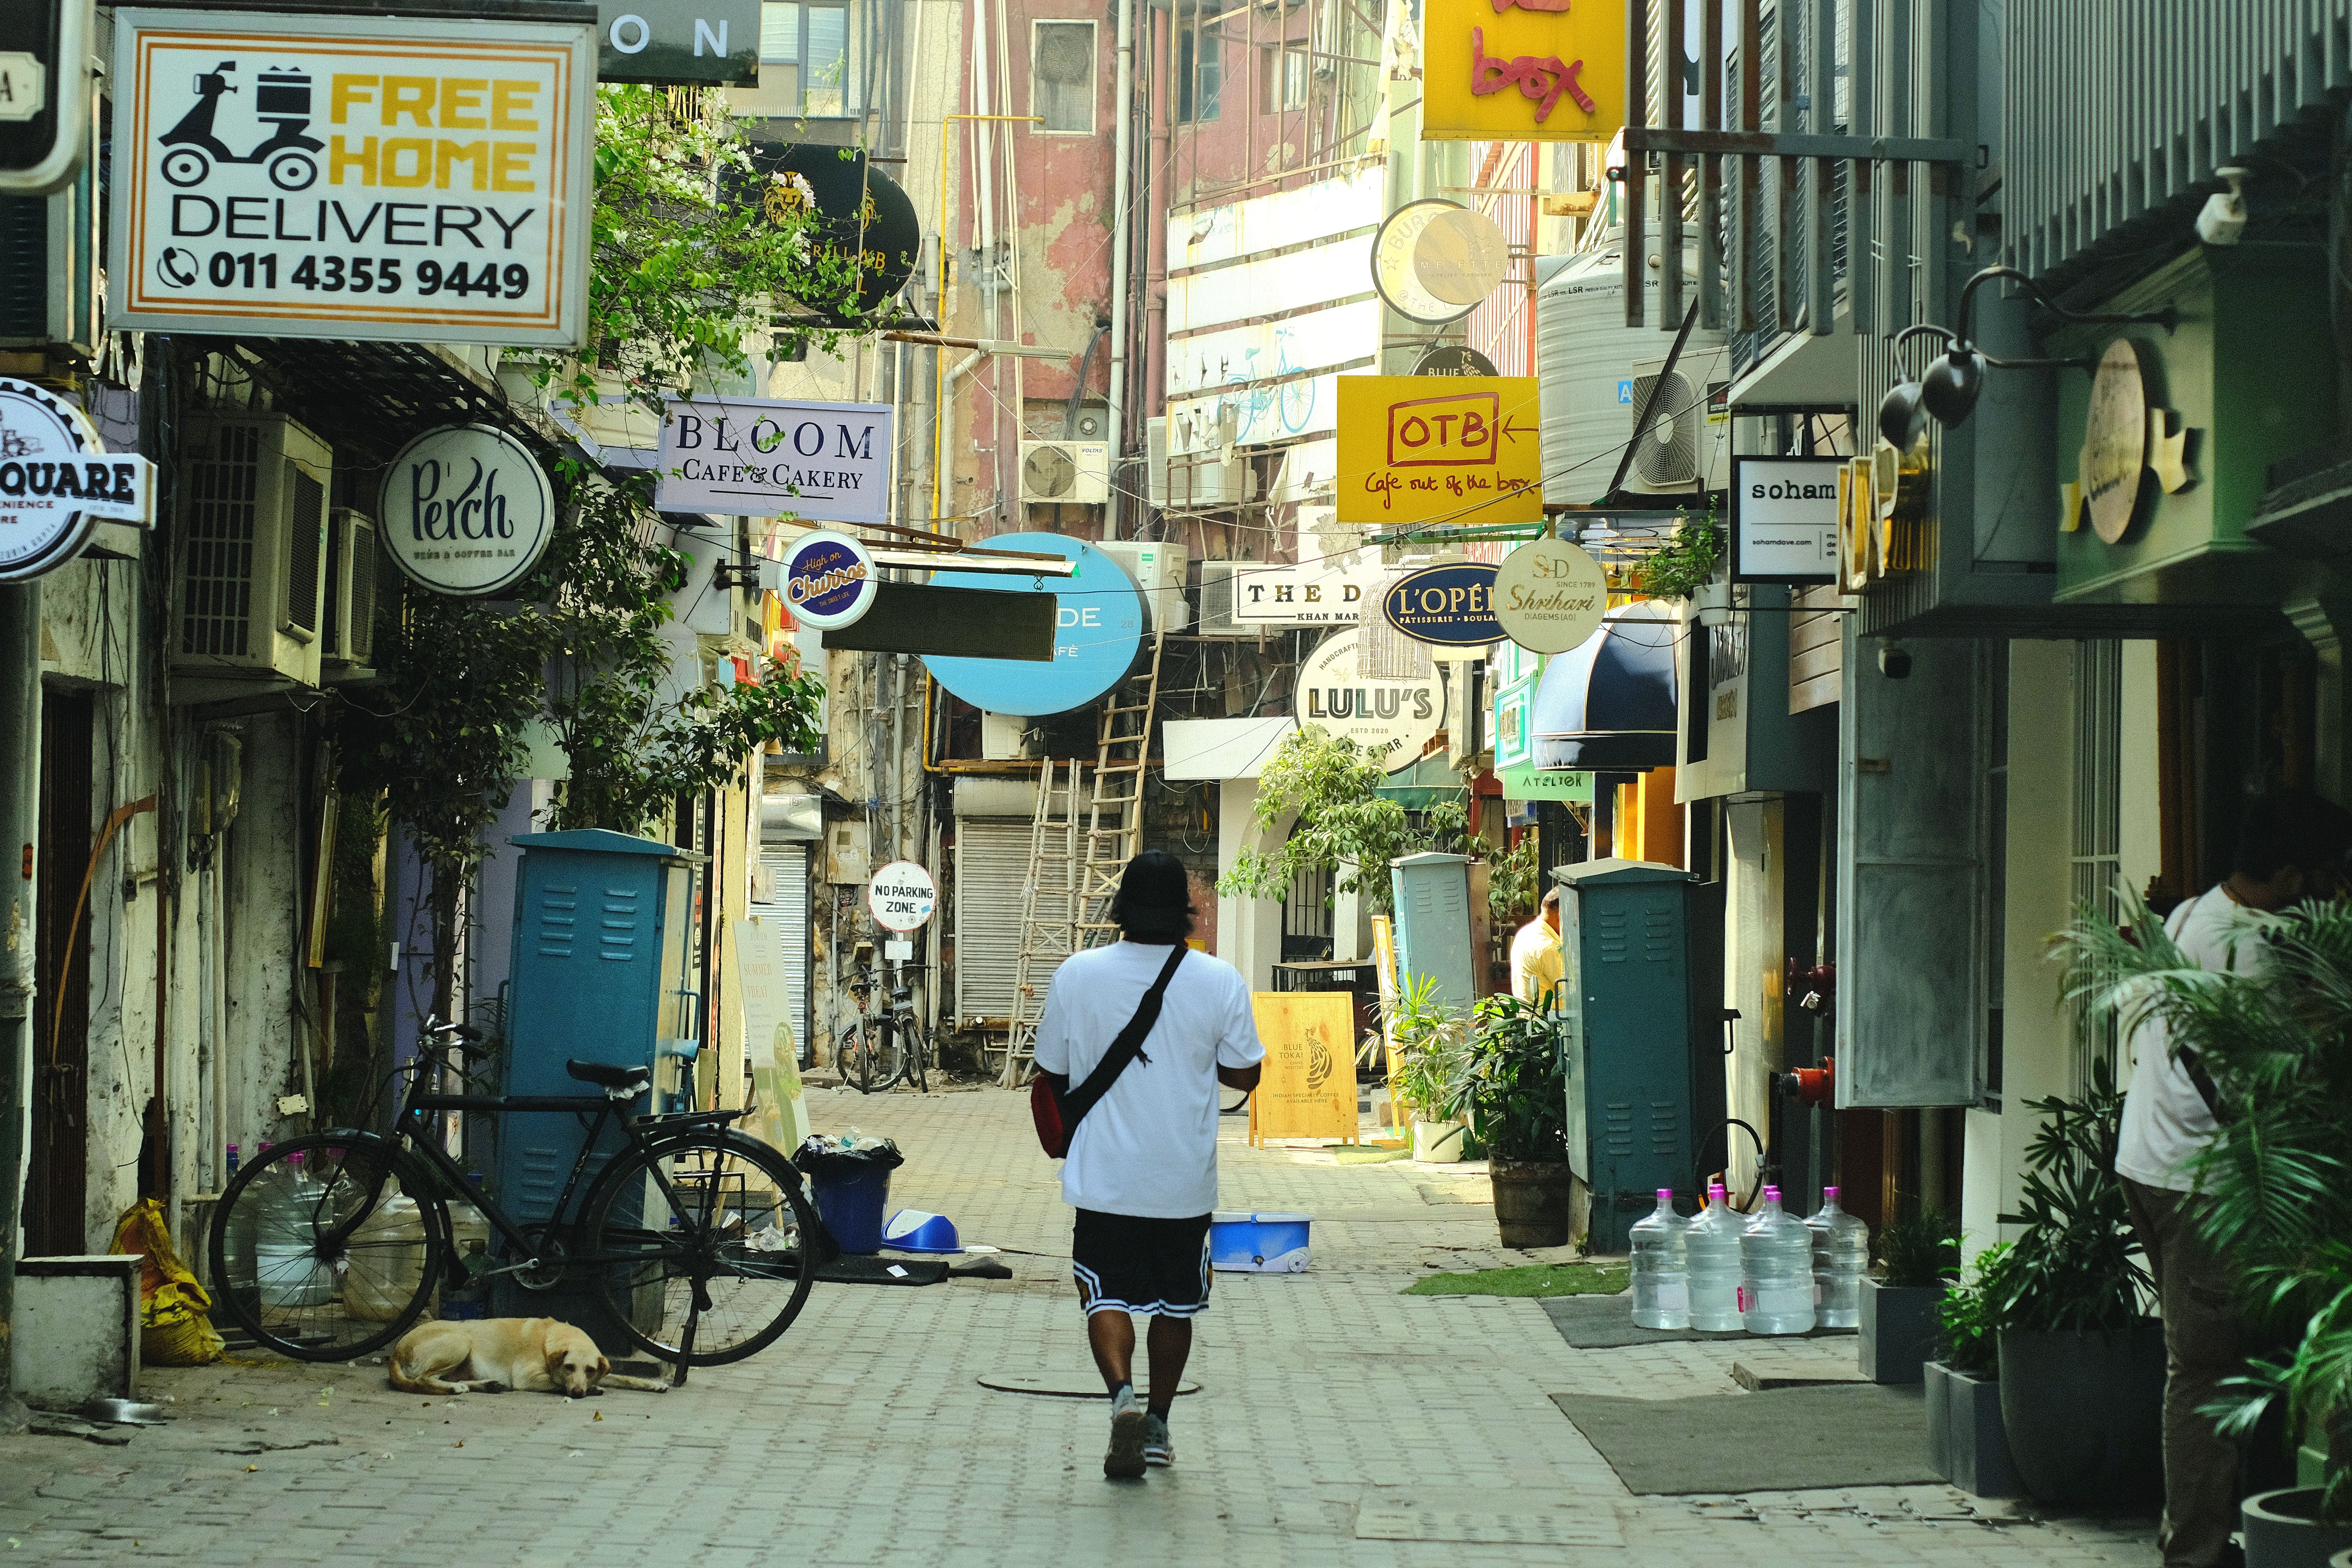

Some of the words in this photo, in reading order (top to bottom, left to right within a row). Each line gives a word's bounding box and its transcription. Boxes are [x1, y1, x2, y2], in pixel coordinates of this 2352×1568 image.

[1472, 26, 1595, 123] box
[331, 74, 541, 131] FREE
[329, 135, 536, 192] HOME
[172, 194, 535, 249] DELIVERY
[209, 251, 276, 288] 011
[291, 255, 401, 294] 4355
[416, 260, 529, 299] 9449
[676, 415, 875, 459] BLOOM
[1400, 412, 1489, 447] OTB
[750, 467, 767, 483] &
[1365, 472, 1402, 509] Cafe
[1410, 477, 1438, 490] out
[1446, 475, 1463, 497] of
[1467, 474, 1491, 489] the
[1497, 471, 1538, 498] box
[455, 550, 493, 559] COFFEE
[498, 549, 515, 558] BAR
[802, 553, 828, 573] High
[830, 551, 842, 562] on
[787, 561, 867, 605] Churros
[1248, 585, 1321, 602] THE
[828, 594, 841, 604] SWEET
[841, 591, 849, 601] LIFE
[1506, 584, 1595, 611] Shrihari
[1309, 688, 1433, 719] LULU'S
[1385, 738, 1403, 756] AR
[875, 885, 890, 896] NO
[892, 886, 933, 899] PARKING
[886, 902, 916, 914] ZONE
[744, 963, 772, 976] SUMMER
[747, 985, 768, 998] TREAT
